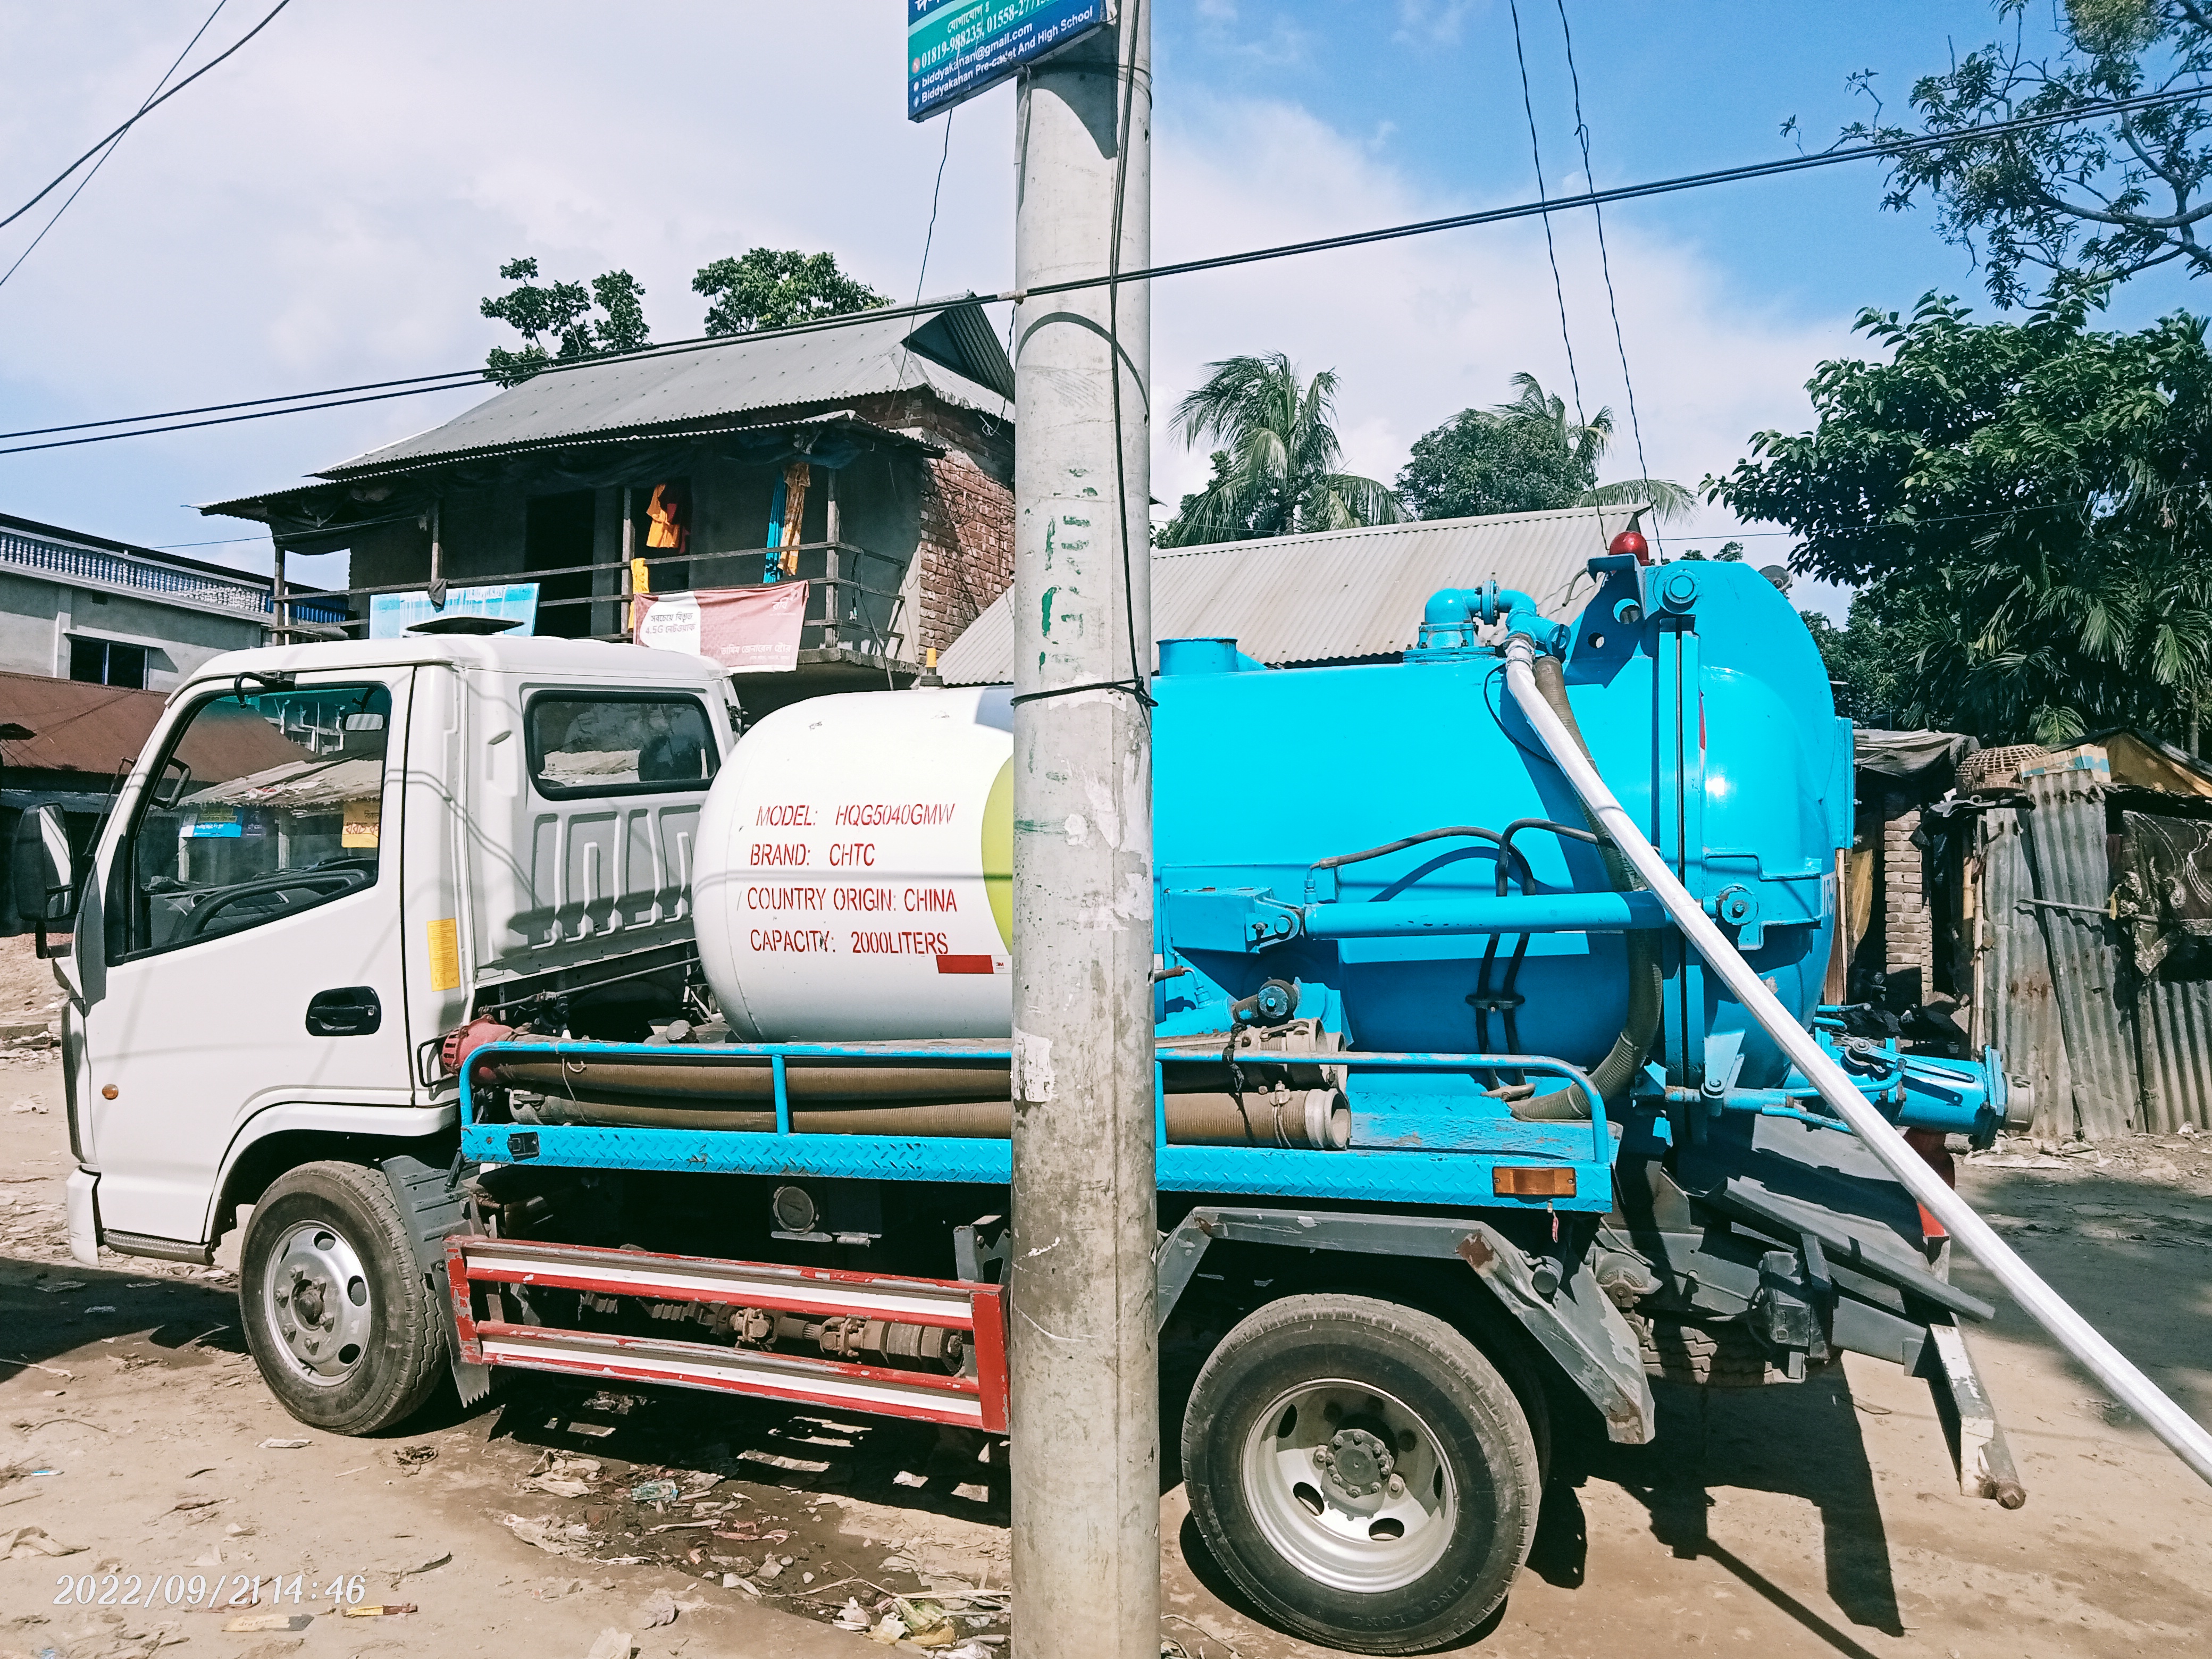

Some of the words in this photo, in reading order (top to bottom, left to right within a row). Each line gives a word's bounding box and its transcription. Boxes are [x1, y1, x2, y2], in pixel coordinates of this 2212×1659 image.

[948, 4, 983, 33] যোগাযোগ
[1018, 36, 1036, 56] And
[1037, 24, 1058, 45] High
[1060, 5, 1093, 31] School
[772, 597, 789, 611] রবি
[646, 625, 664, 634] 4.5G
[651, 614, 674, 623] সবচেয়ে
[721, 644, 740, 655] তামিম
[756, 805, 818, 826] MODEL:
[835, 803, 956, 826] HQG5040GMW
[750, 843, 811, 866] BRAND:
[830, 843, 875, 866] CHTC
[748, 886, 827, 910] COUNTRY
[833, 887, 896, 911] ORIGIN:
[904, 888, 958, 912] CHINA
[750, 929, 836, 953] CAPACITY:
[851, 931, 949, 955] 2000LITERS
